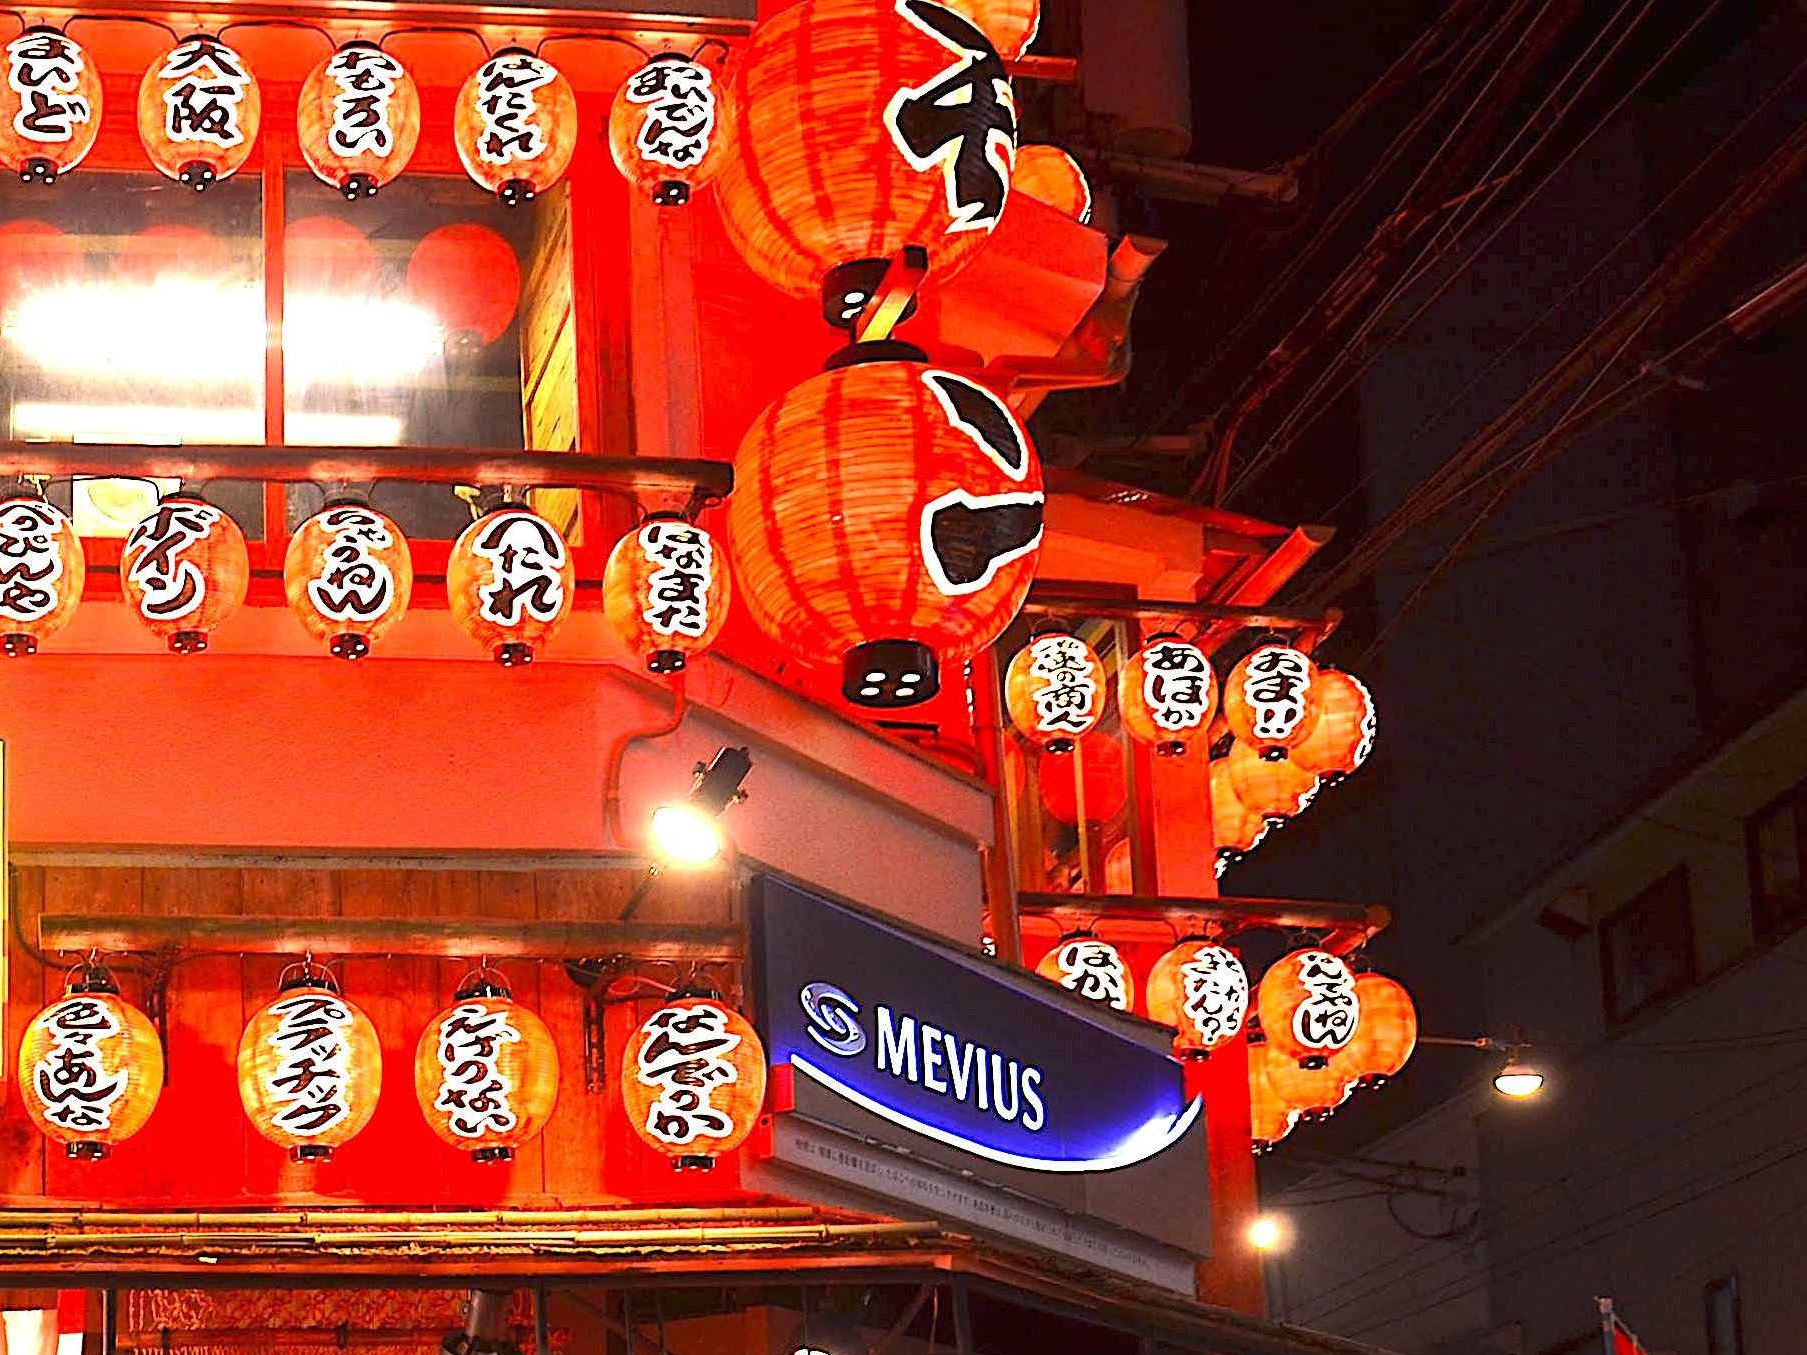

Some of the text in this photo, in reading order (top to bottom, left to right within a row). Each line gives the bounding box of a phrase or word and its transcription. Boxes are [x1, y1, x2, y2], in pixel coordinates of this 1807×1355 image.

[18, 36, 85, 133] まいど
[170, 41, 242, 140] 大阪
[481, 517, 559, 619] へたれ
[1150, 645, 1205, 727] あほか
[441, 1009, 512, 1133] えげつない
[877, 1006, 1046, 1132] MEVIUS
